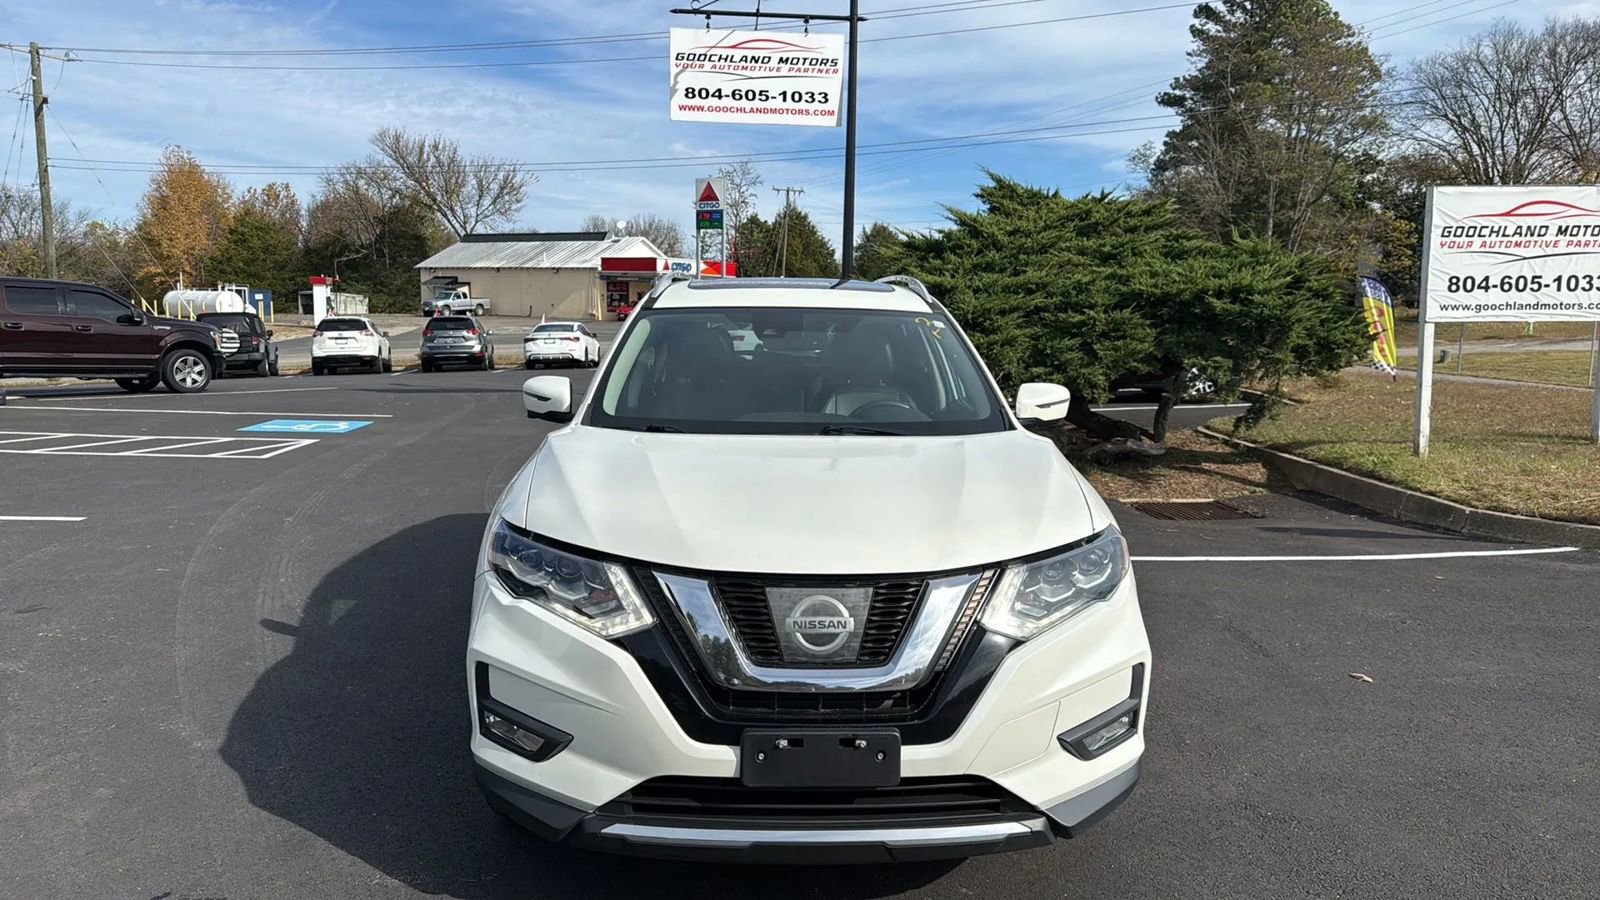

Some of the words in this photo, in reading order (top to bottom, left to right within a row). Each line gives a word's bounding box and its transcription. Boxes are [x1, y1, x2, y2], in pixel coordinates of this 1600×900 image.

[675, 52, 772, 65] GOOCHLAND
[777, 56, 839, 67] MOTORS
[675, 62, 705, 70] YOUR
[710, 63, 783, 73] AUTOMOTIVE
[788, 66, 839, 75] PARTNER
[684, 86, 829, 104] 804-605-1033
[678, 104, 835, 116] WWW.GOOCHLANDMOTORS.COM
[1440, 225, 1550, 238] GOOCHLAND
[1439, 240, 1474, 249] YOUR
[1479, 240, 1561, 249] AUTOMOTIVE
[1565, 239, 1600, 248] PART
[671, 262, 692, 272] CITGO
[793, 620, 847, 630] NISSAN
